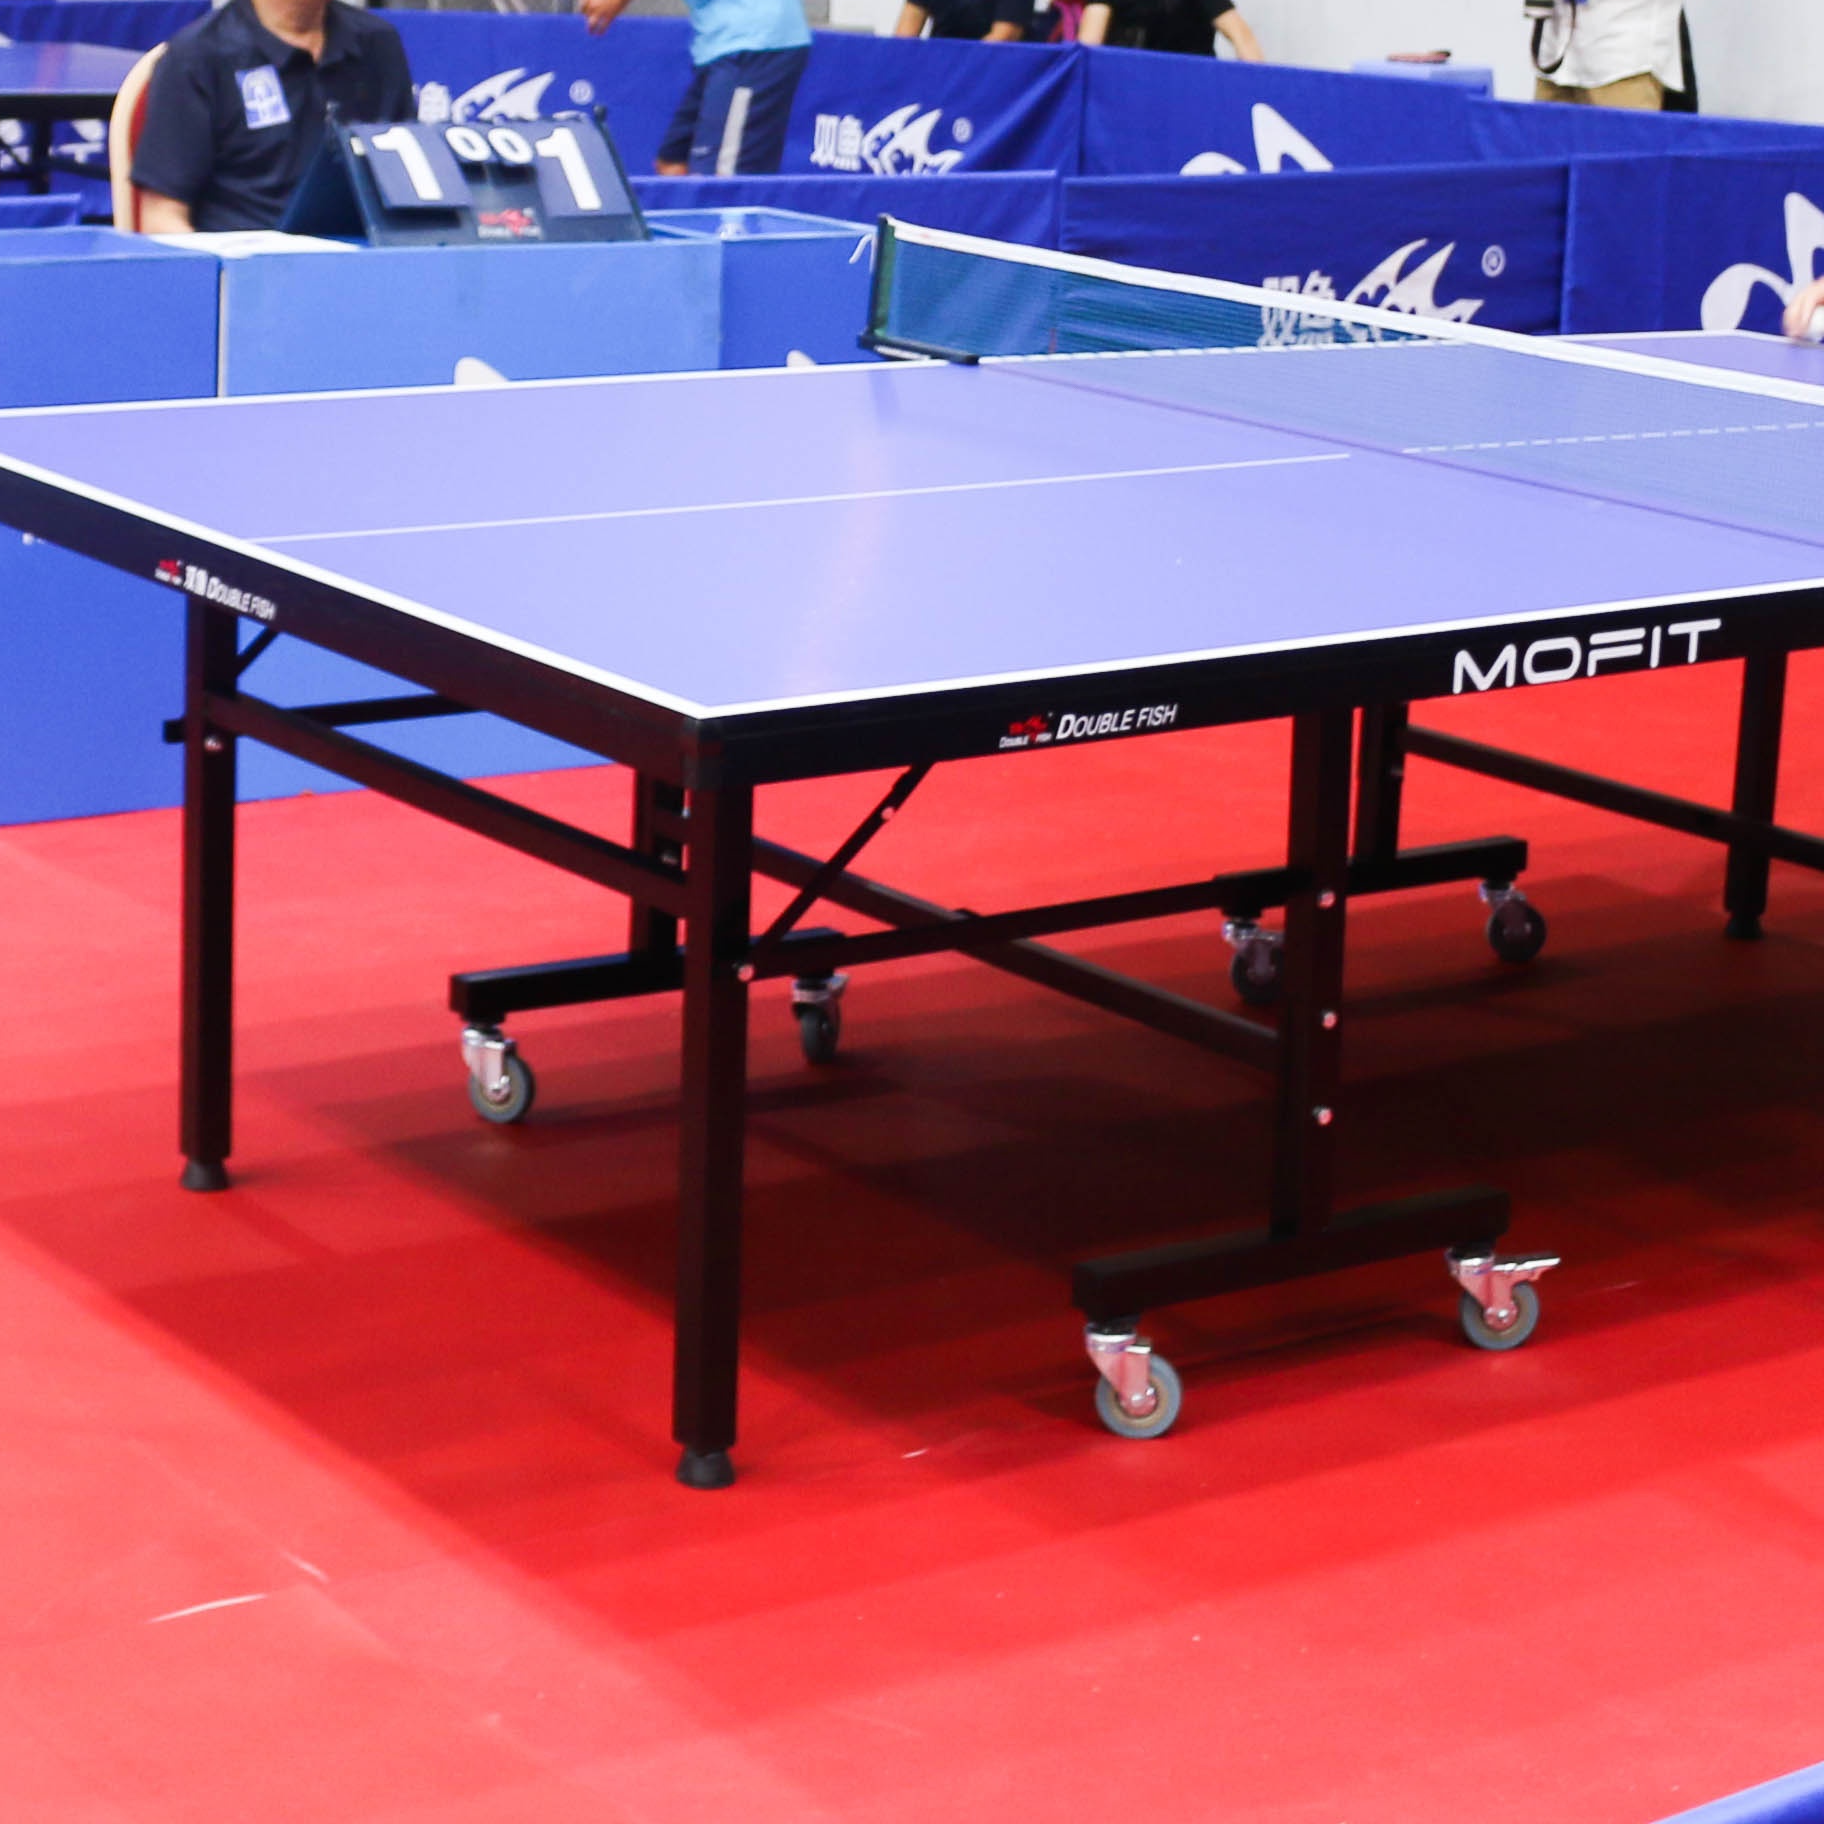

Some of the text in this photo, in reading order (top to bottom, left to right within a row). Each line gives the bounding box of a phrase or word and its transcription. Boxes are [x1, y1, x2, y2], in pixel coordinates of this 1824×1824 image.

[371, 126, 443, 201] 1
[535, 127, 602, 211] 1
[1452, 618, 1722, 695] MOFIT
[1056, 703, 1178, 740] DOUBLE FISH
